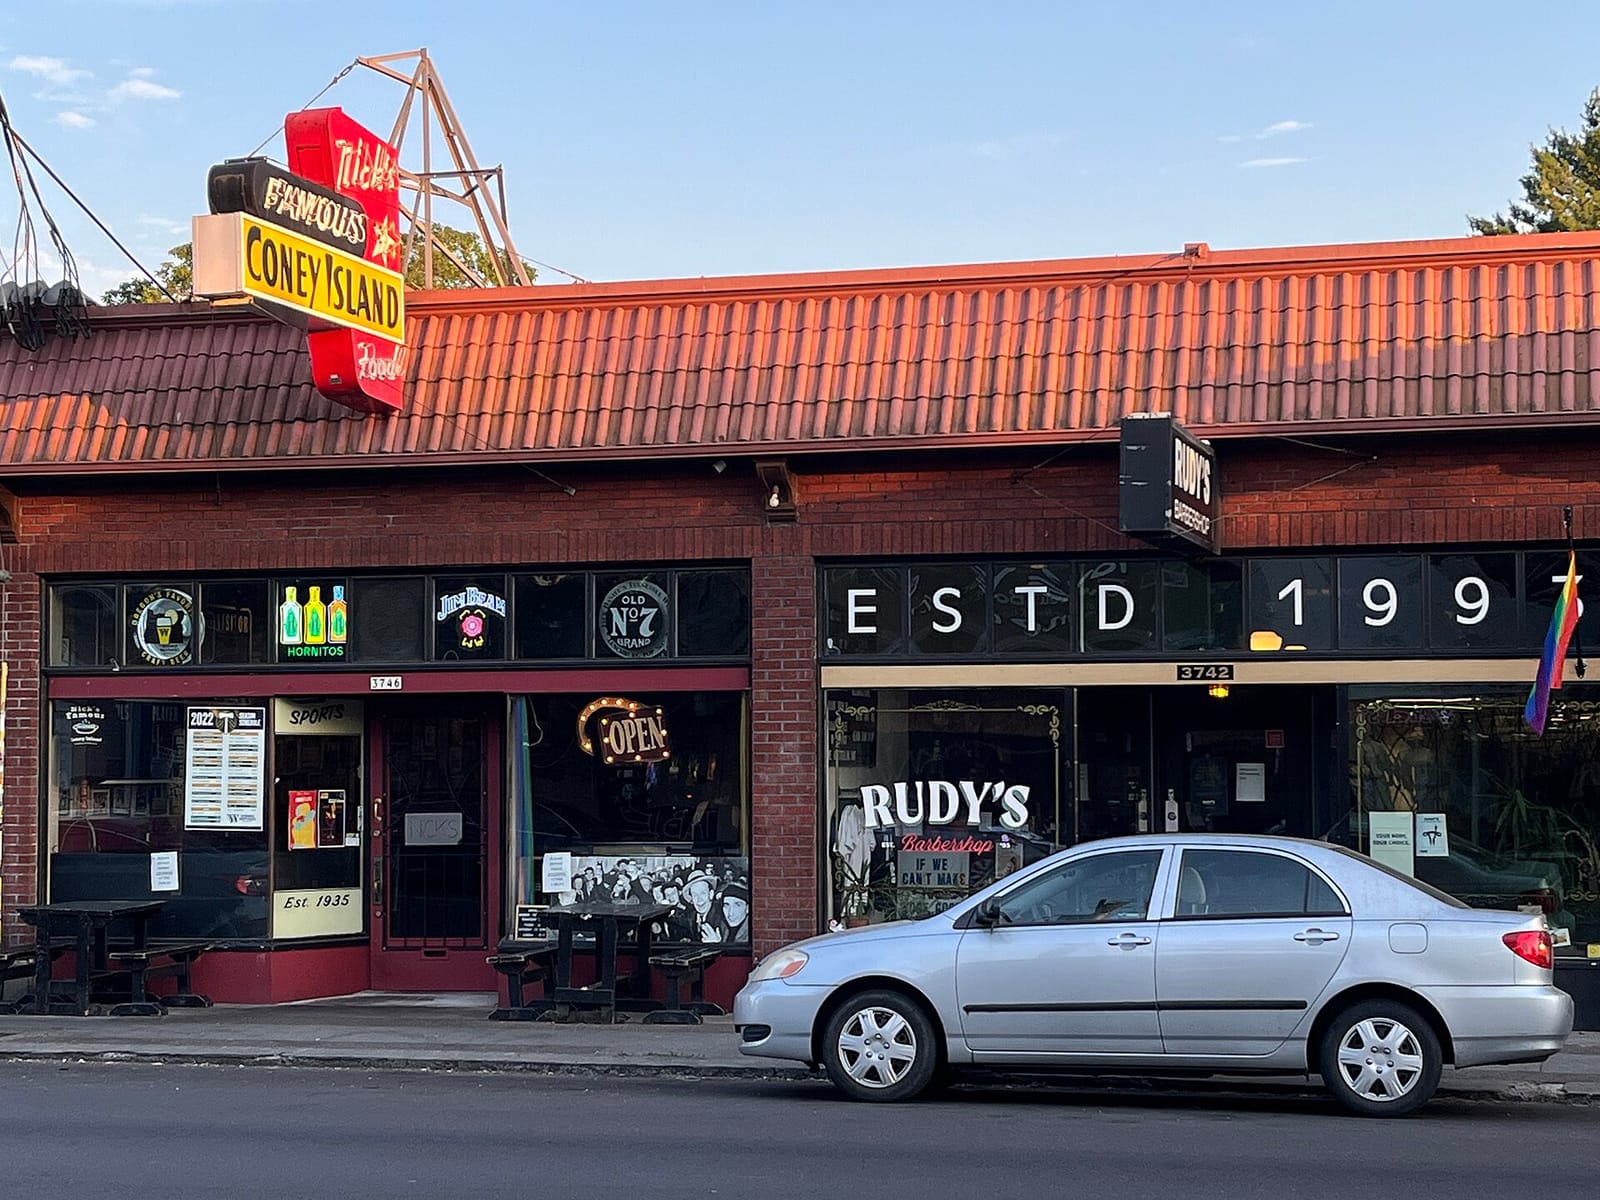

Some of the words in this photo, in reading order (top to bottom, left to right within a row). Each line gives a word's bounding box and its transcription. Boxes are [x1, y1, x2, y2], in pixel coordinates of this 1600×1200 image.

[264, 175, 368, 245] FAMOUS
[246, 225, 322, 309] CONEY
[326, 252, 399, 328] ISLAND
[1174, 437, 1211, 505] RUDY'S
[437, 592, 467, 621] JIM
[621, 595, 646, 605] OLD
[287, 646, 344, 657] HORNITOS
[1180, 665, 1231, 679] 3742
[371, 678, 401, 689] 3746
[190, 711, 214, 726] 2022
[289, 703, 345, 725] SPORTS
[608, 715, 663, 755] OPEN
[859, 780, 1031, 829] RUDY'S
[901, 832, 994, 857] Barbershop
[916, 858, 926, 871] IF
[932, 858, 948, 871] WE
[316, 894, 350, 907] 1935
